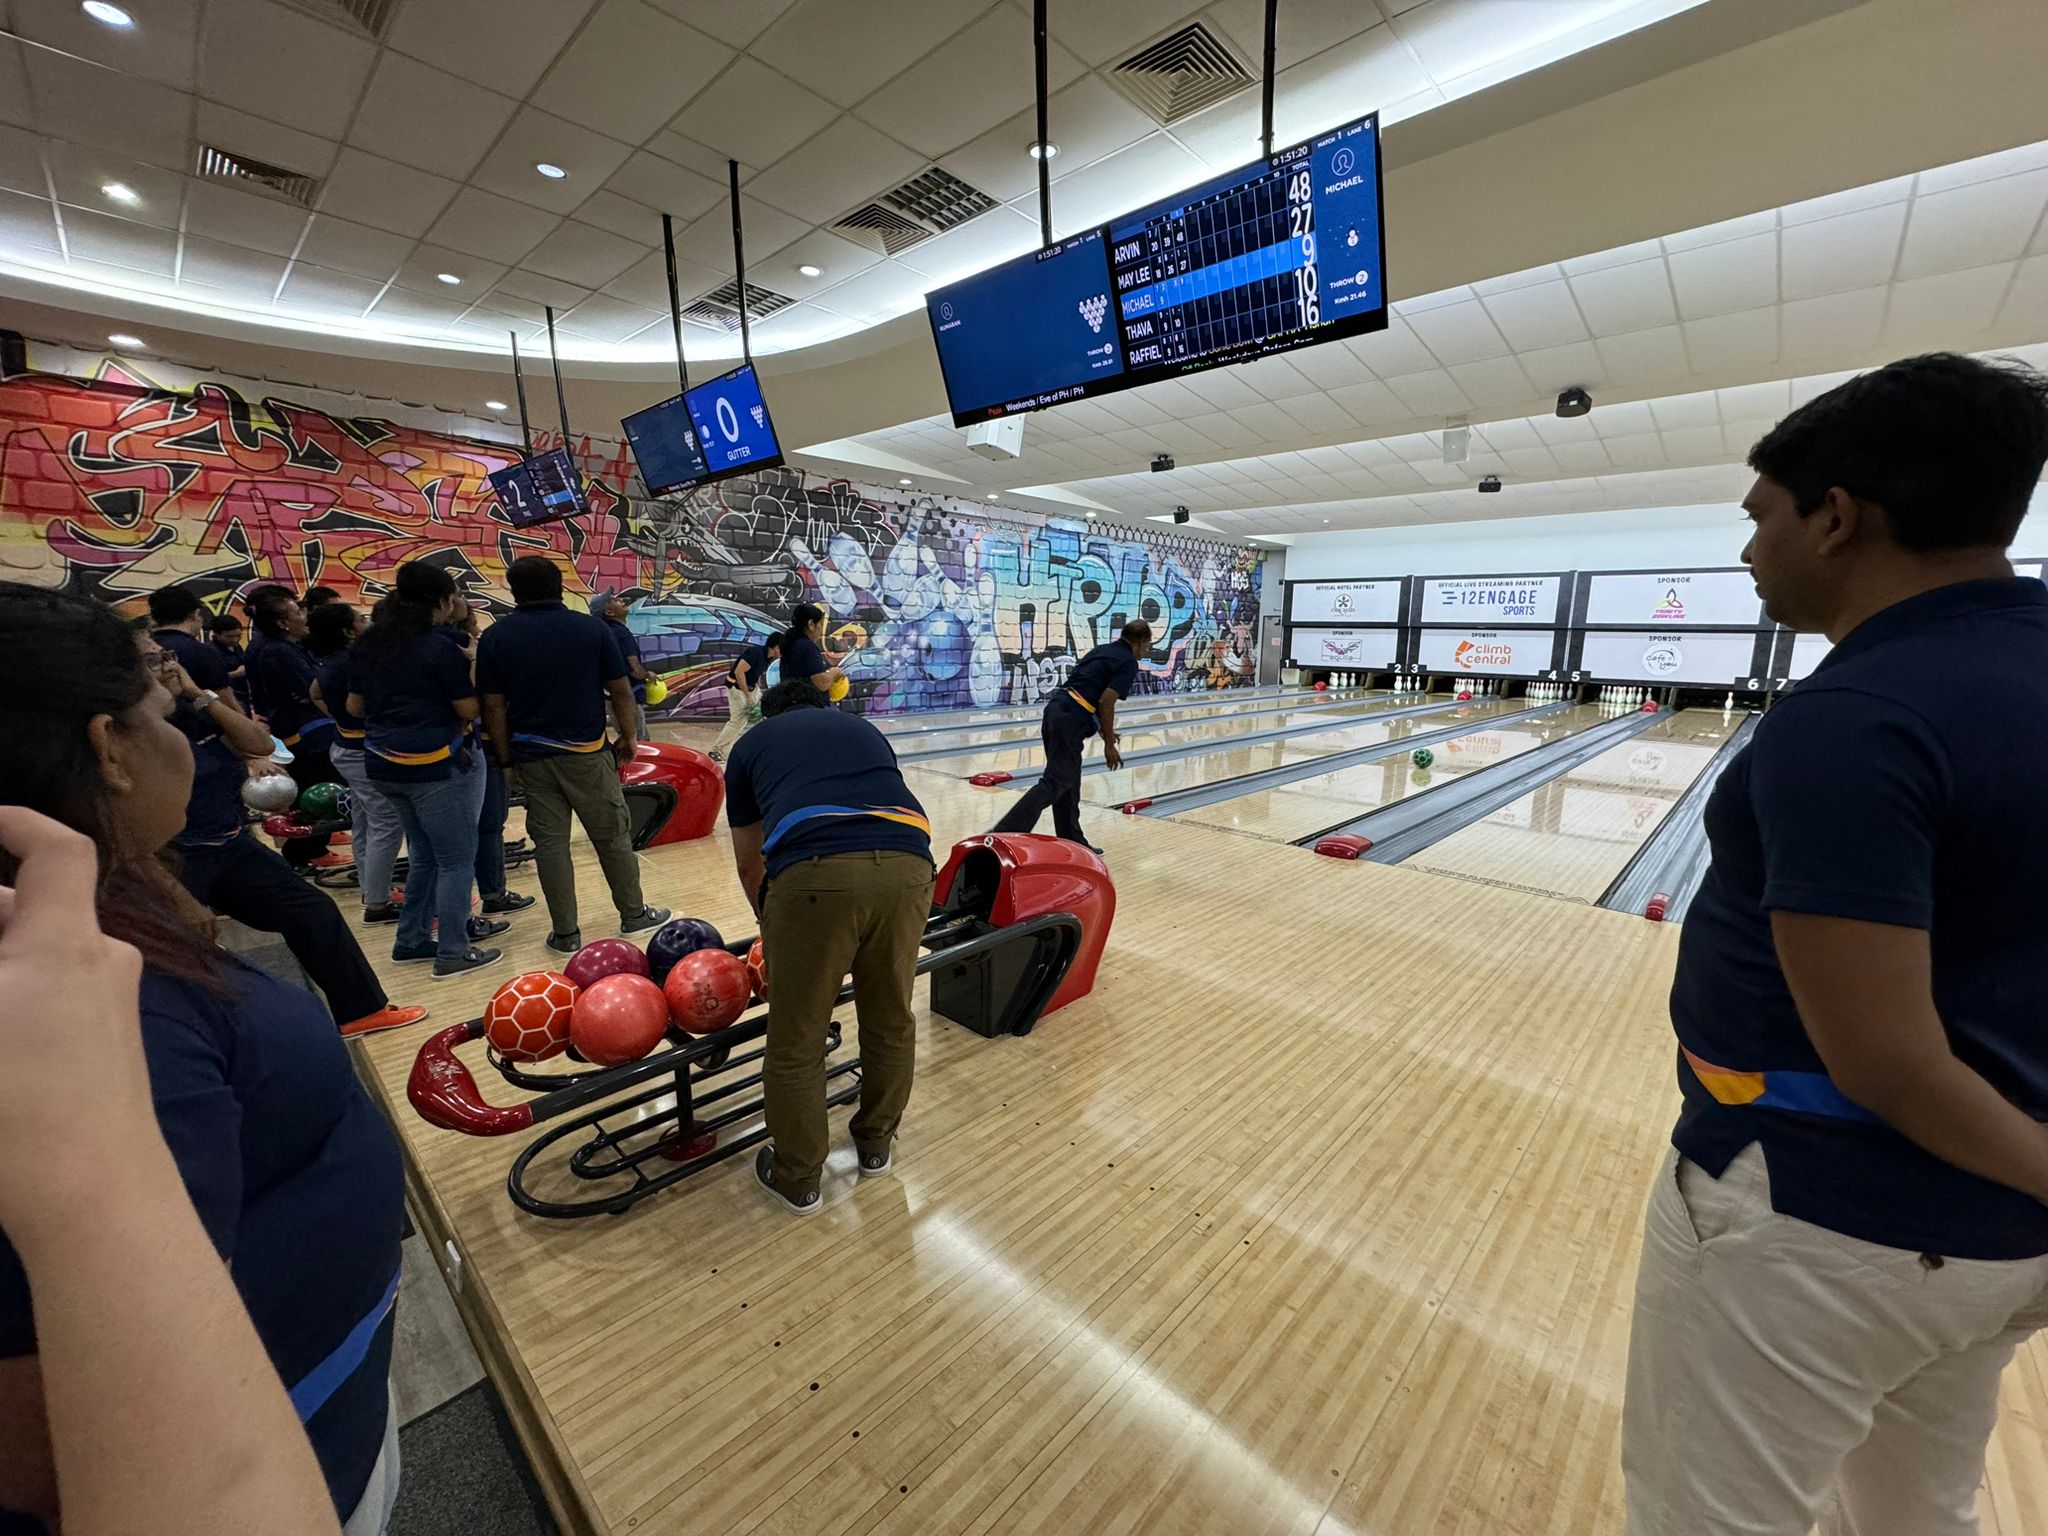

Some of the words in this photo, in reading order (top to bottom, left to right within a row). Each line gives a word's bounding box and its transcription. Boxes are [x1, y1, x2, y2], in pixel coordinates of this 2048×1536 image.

[1318, 138, 1336, 148] MATCH
[1337, 131, 1342, 140] 1
[1347, 126, 1362, 136] LANE
[1364, 119, 1371, 129] 6
[1279, 146, 1308, 164] 1:51:20
[1291, 161, 1310, 171] TOTAL
[1288, 171, 1311, 203] 48
[1325, 176, 1364, 195] MICHAEL
[1290, 202, 1313, 238] 27
[1114, 240, 1140, 264] ARVIN
[1301, 233, 1315, 267] 9
[1117, 271, 1134, 290] MAY
[1135, 266, 1151, 284] LEE
[1294, 265, 1318, 299] 10
[1329, 277, 1355, 289] THROW
[1121, 294, 1155, 315] MICHAEL
[1297, 294, 1320, 327] 16
[1125, 320, 1154, 340] THAVA
[1129, 344, 1162, 365] RAFFIEL
[1005, 398, 1036, 412] Weekends
[1039, 393, 1052, 404] Eve
[1052, 391, 1059, 401] of
[1059, 389, 1070, 400] PH
[1073, 385, 1085, 397] PH
[715, 397, 739, 443] 0
[727, 446, 752, 461] GUTTER
[508, 480, 527, 508] 2
[1503, 605, 1535, 616] SPORTS
[1475, 644, 1512, 655] climb
[1284, 659, 1290, 668] 1
[1393, 664, 1401, 673] 2
[1410, 664, 1419, 674] 3
[1465, 655, 1511, 665] central
[1547, 670, 1557, 681] 4
[1571, 671, 1580, 682] 5
[1747, 679, 1759, 690] 6
[1775, 679, 1788, 690] 7
